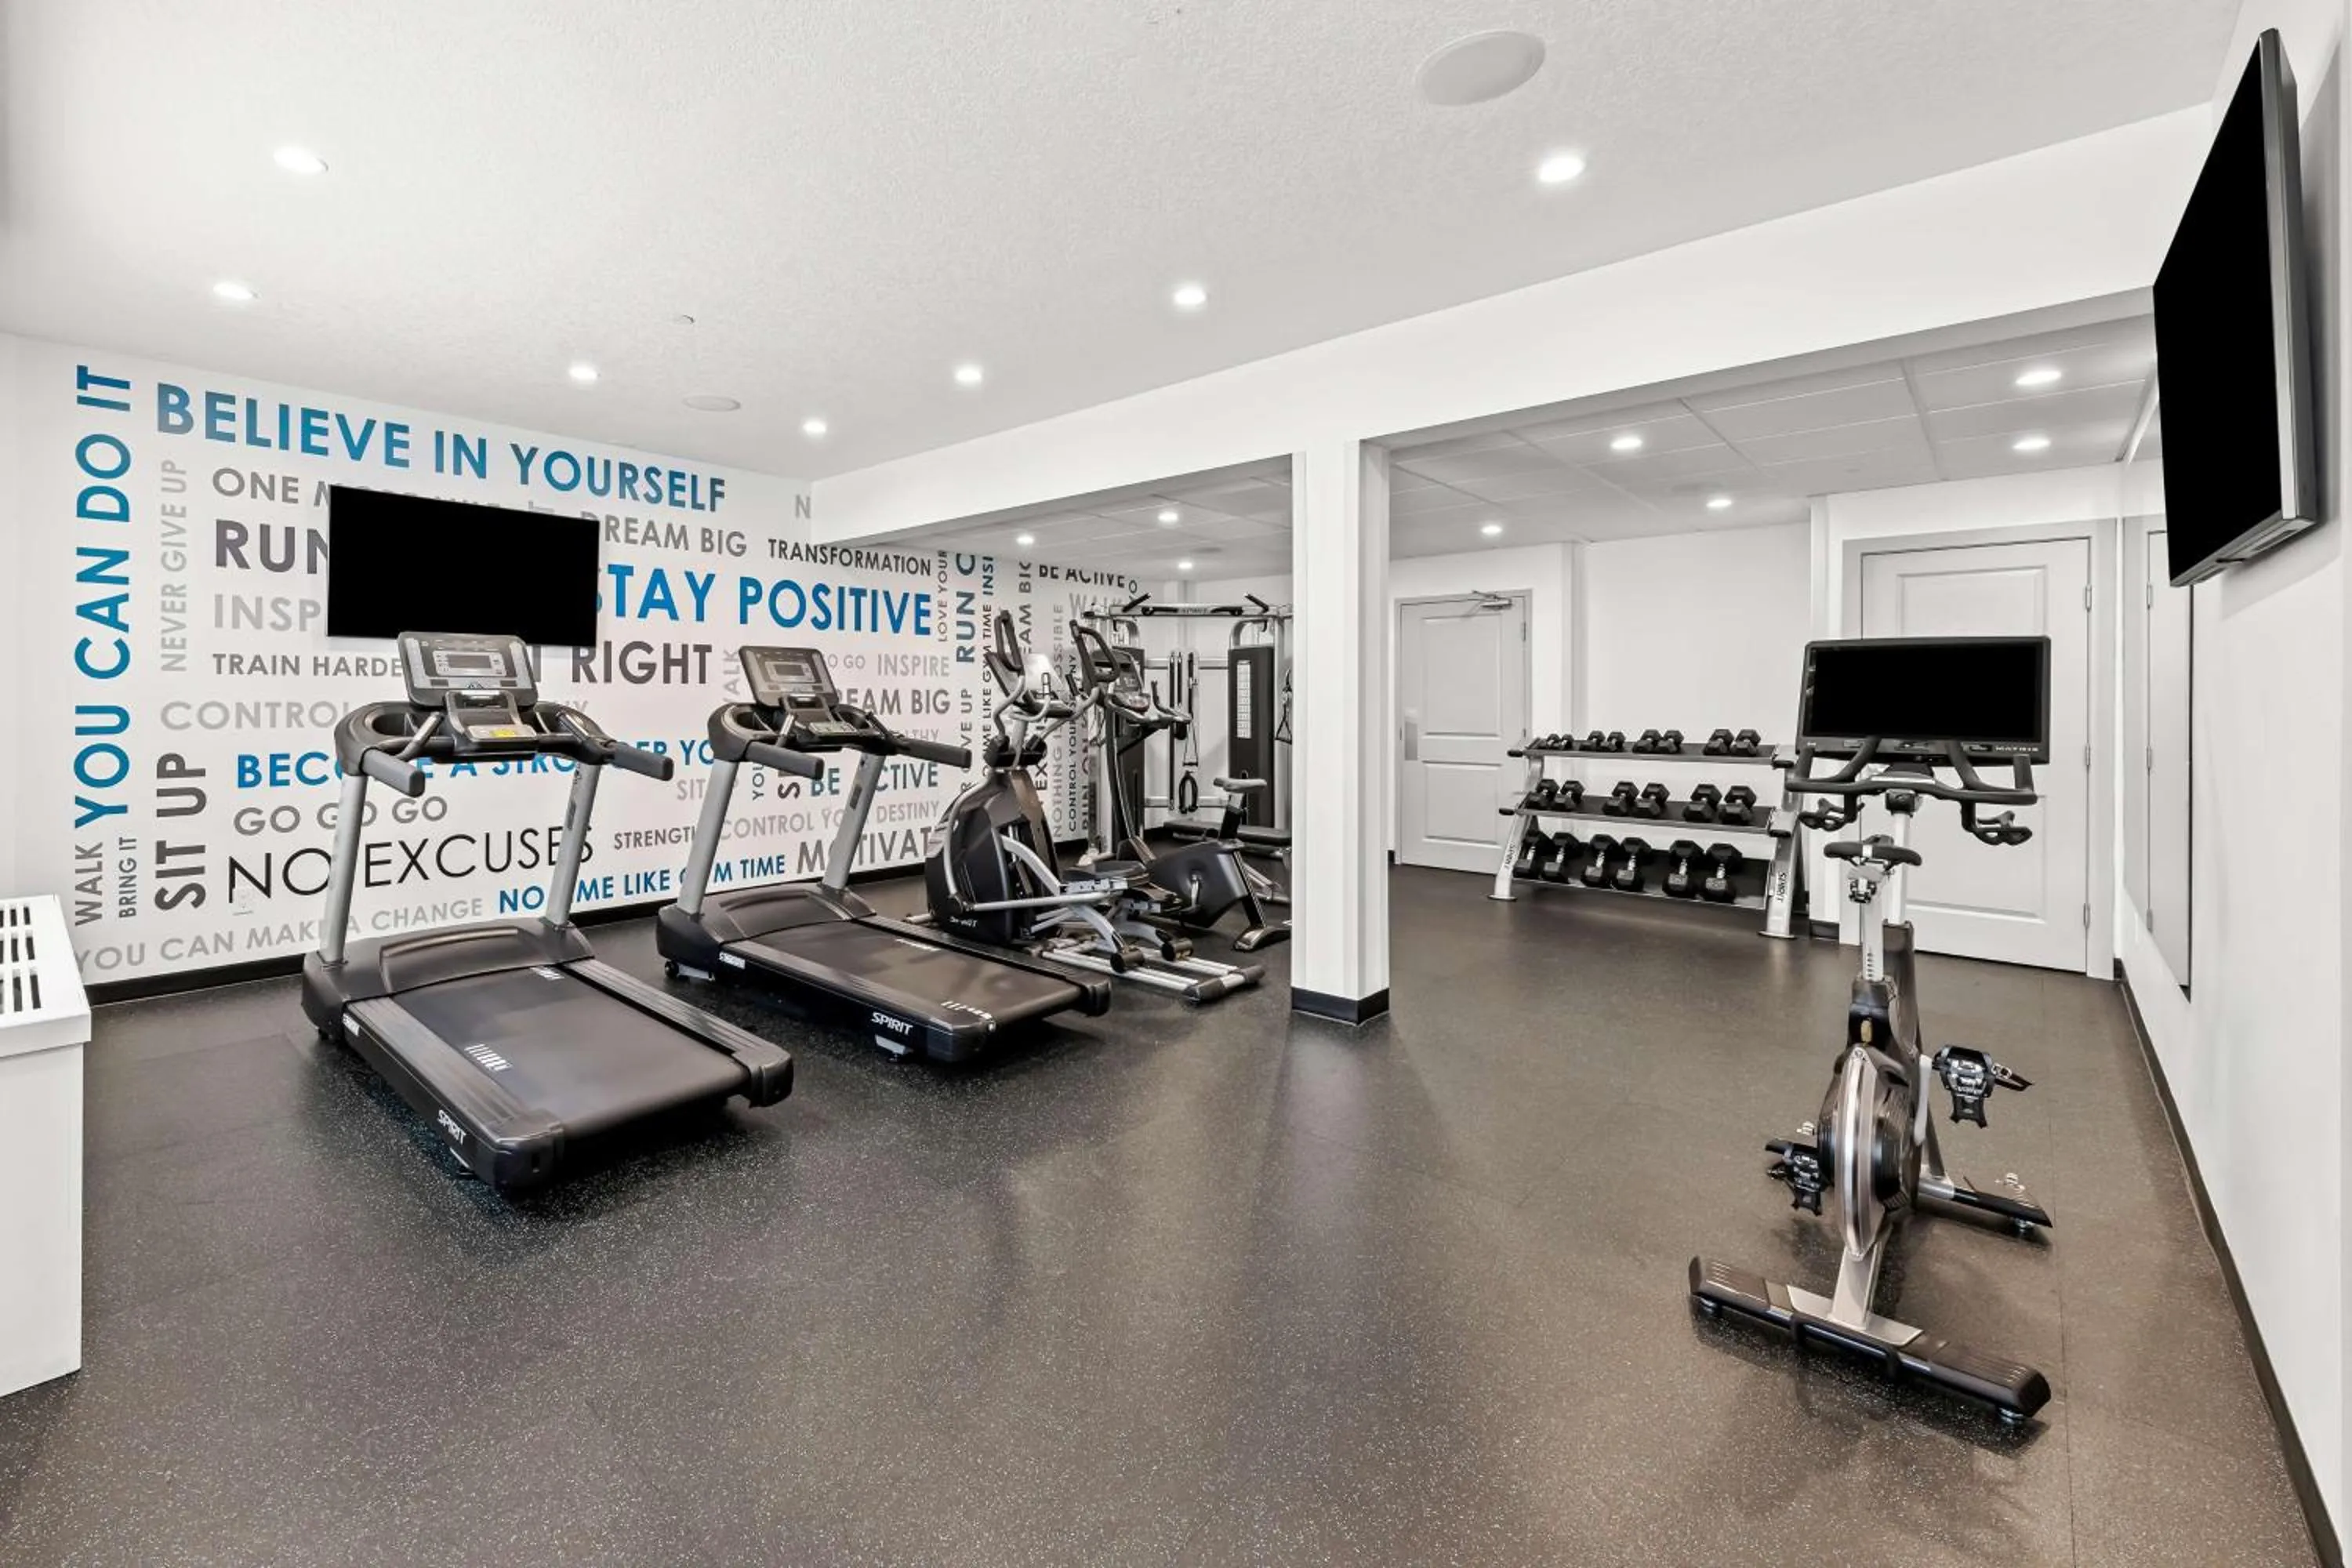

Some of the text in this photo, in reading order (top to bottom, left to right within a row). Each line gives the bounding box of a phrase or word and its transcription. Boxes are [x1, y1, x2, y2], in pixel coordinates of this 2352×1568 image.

[157, 382, 725, 512] BELIEVE IN YOURSELF
[212, 467, 299, 504] ONE
[581, 510, 747, 557] REAM BIG
[161, 459, 187, 672] NEVER GIVE UP
[768, 539, 931, 576] TRANSFORMATION
[74, 365, 131, 829] YOU CAN DO IT
[214, 593, 321, 632] INSP
[597, 563, 931, 635] TAY POSITIVE
[938, 601, 948, 642] LOVE
[956, 591, 975, 662] RUN
[983, 604, 992, 640] TIME
[212, 653, 401, 677] TRAIN HARDE
[572, 641, 712, 684] RIGHT
[723, 649, 741, 702] ALK
[844, 655, 866, 670] GO
[877, 653, 950, 677] INSPIRE
[838, 688, 951, 715] EAM BIG
[961, 688, 972, 714] UP
[982, 688, 992, 719] LIKE
[679, 739, 714, 766] YO
[677, 779, 706, 800] SIT
[154, 753, 206, 910] SIT UP
[234, 805, 301, 837] GO
[392, 796, 448, 824] GO
[721, 801, 940, 840] CONTROL YO DESTINY
[739, 855, 785, 879] TIME
[797, 826, 932, 875] MTIVAT
[74, 842, 103, 926] WALK
[118, 837, 136, 918] BRING IT
[229, 847, 332, 904] NO
[499, 885, 545, 913] NO
[577, 876, 614, 902] ME
[624, 869, 670, 896] LIKE
[161, 931, 234, 961] CAN
[371, 898, 483, 931] CHANGE
[871, 1011, 913, 1036] SPIRIT
